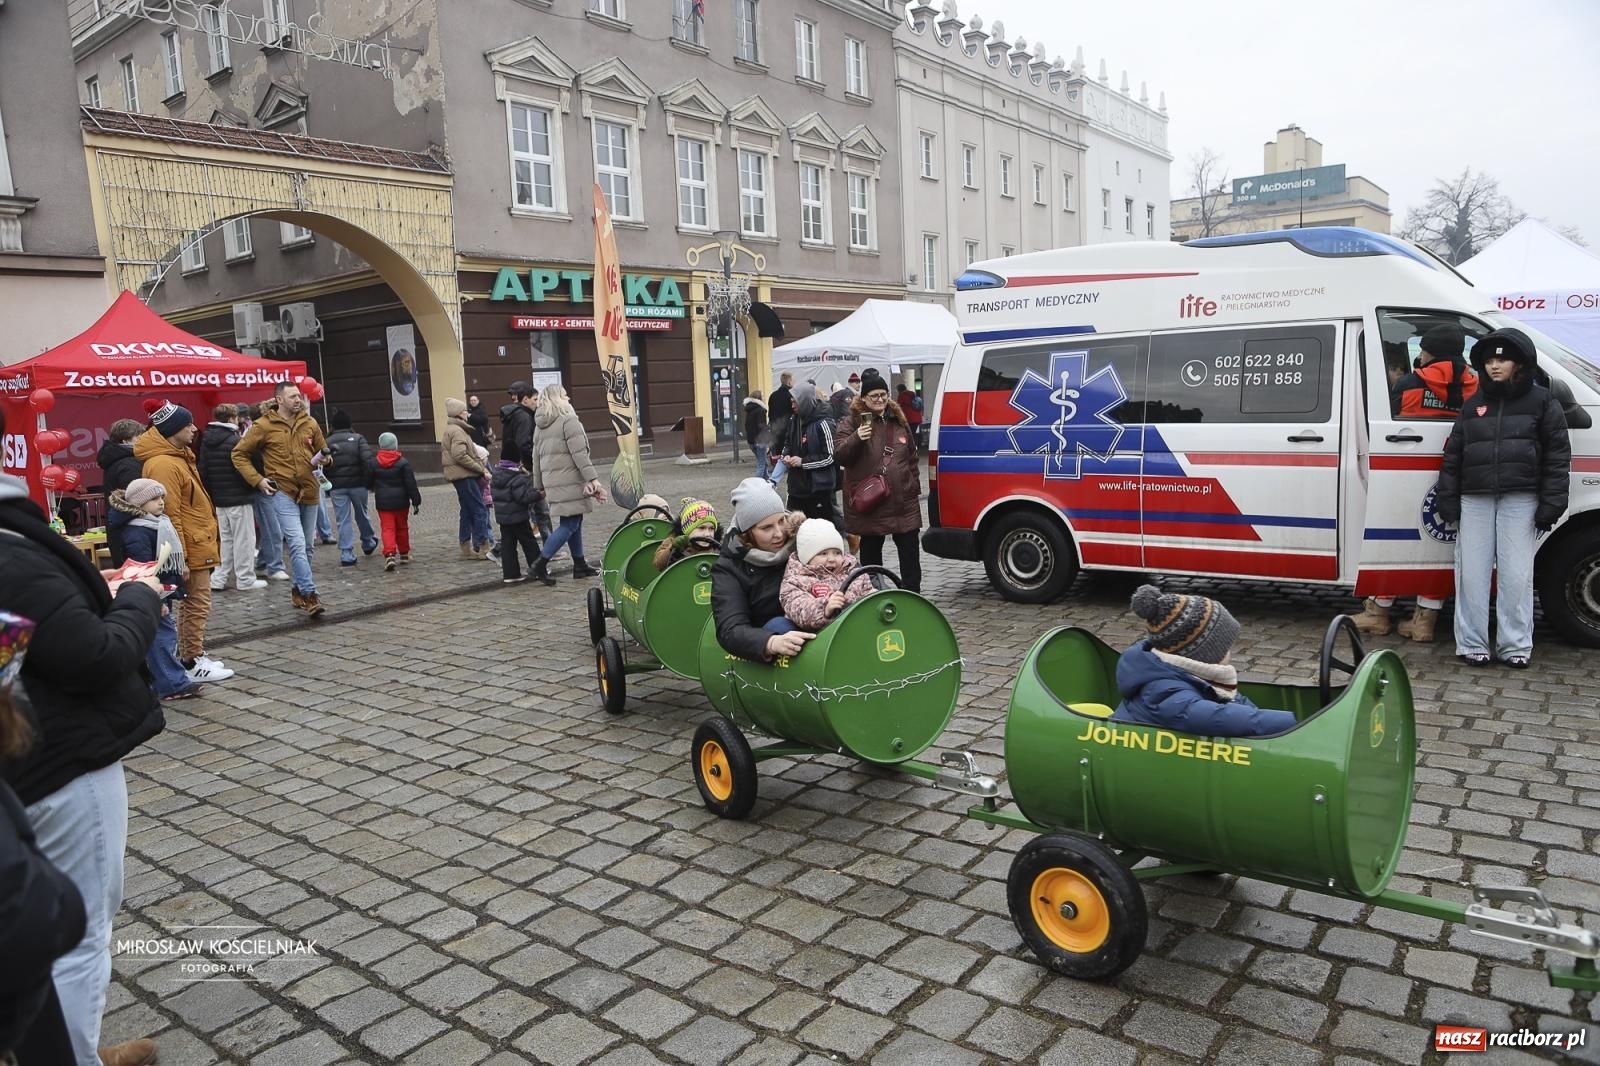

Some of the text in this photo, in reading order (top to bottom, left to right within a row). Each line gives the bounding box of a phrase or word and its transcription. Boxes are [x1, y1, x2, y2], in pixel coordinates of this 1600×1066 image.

[1260, 179, 1316, 193] McDonald's
[490, 267, 685, 306] APTKA
[1221, 287, 1326, 301] RATOWNICTWO MEDYCZNE
[967, 292, 1100, 313] TRANSPORT MEDYCZNY
[1180, 293, 1217, 318] life
[1226, 300, 1291, 311] PIELĘGNIARSTWO
[625, 306, 682, 316] POD RÓŻAMI
[517, 319, 547, 328] RYNEK
[549, 319, 559, 328] 12
[625, 320, 670, 329] ACEUTYCZNE
[90, 343, 193, 356] DKMS
[1215, 353, 1304, 368] 602 622 840
[64, 369, 290, 391] Zostań Dawcą szpiku!
[1213, 372, 1302, 386] 505 751 858
[1424, 390, 1436, 399] RA
[1423, 399, 1443, 409] MED
[1099, 480, 1212, 495] www.life-ratownictwo.pl
[1423, 489, 1437, 513] RAT
[1425, 522, 1457, 541] MEDYC
[1077, 721, 1252, 766] JOHN DEERE
